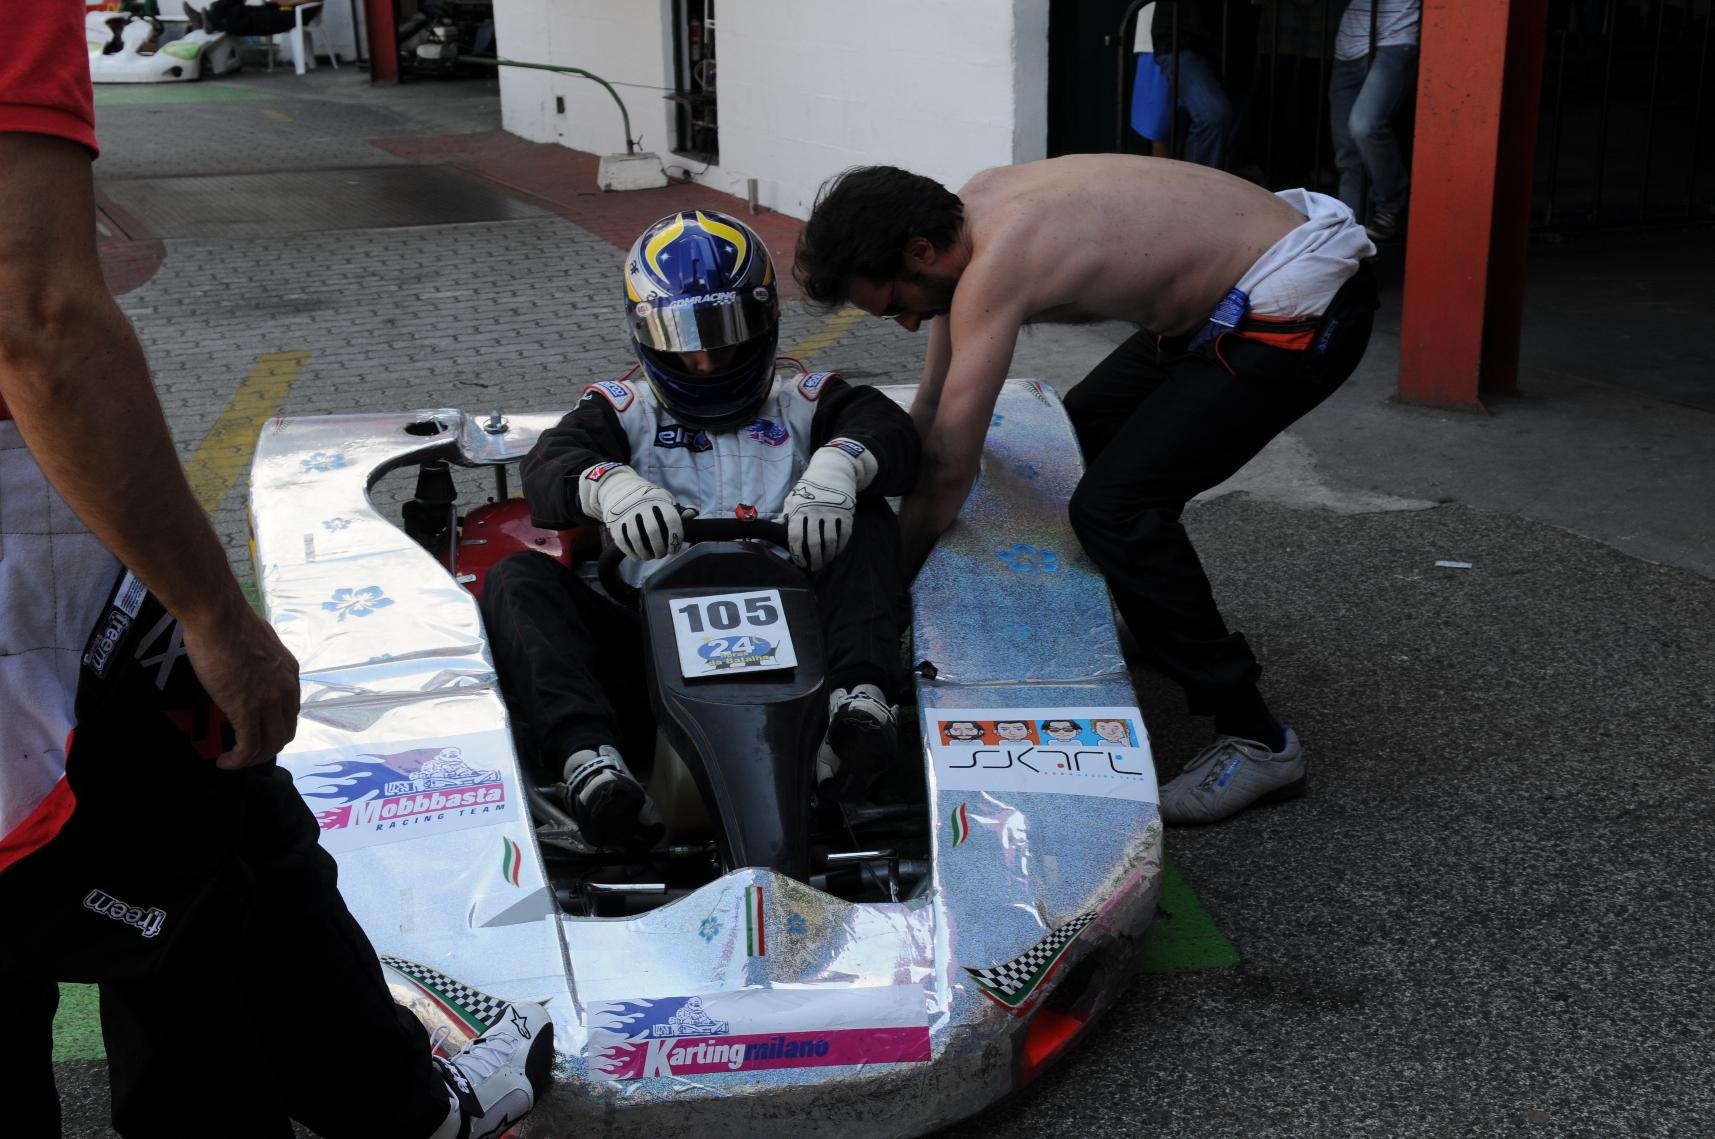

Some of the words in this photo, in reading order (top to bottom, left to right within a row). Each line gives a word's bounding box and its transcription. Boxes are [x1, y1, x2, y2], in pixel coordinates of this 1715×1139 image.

[679, 597, 779, 632] 105
[707, 636, 755, 658] 24
[348, 787, 502, 829] Mobbbasta
[376, 813, 445, 831] RACING
[459, 804, 506, 817] TEAM
[83, 889, 166, 938] freem
